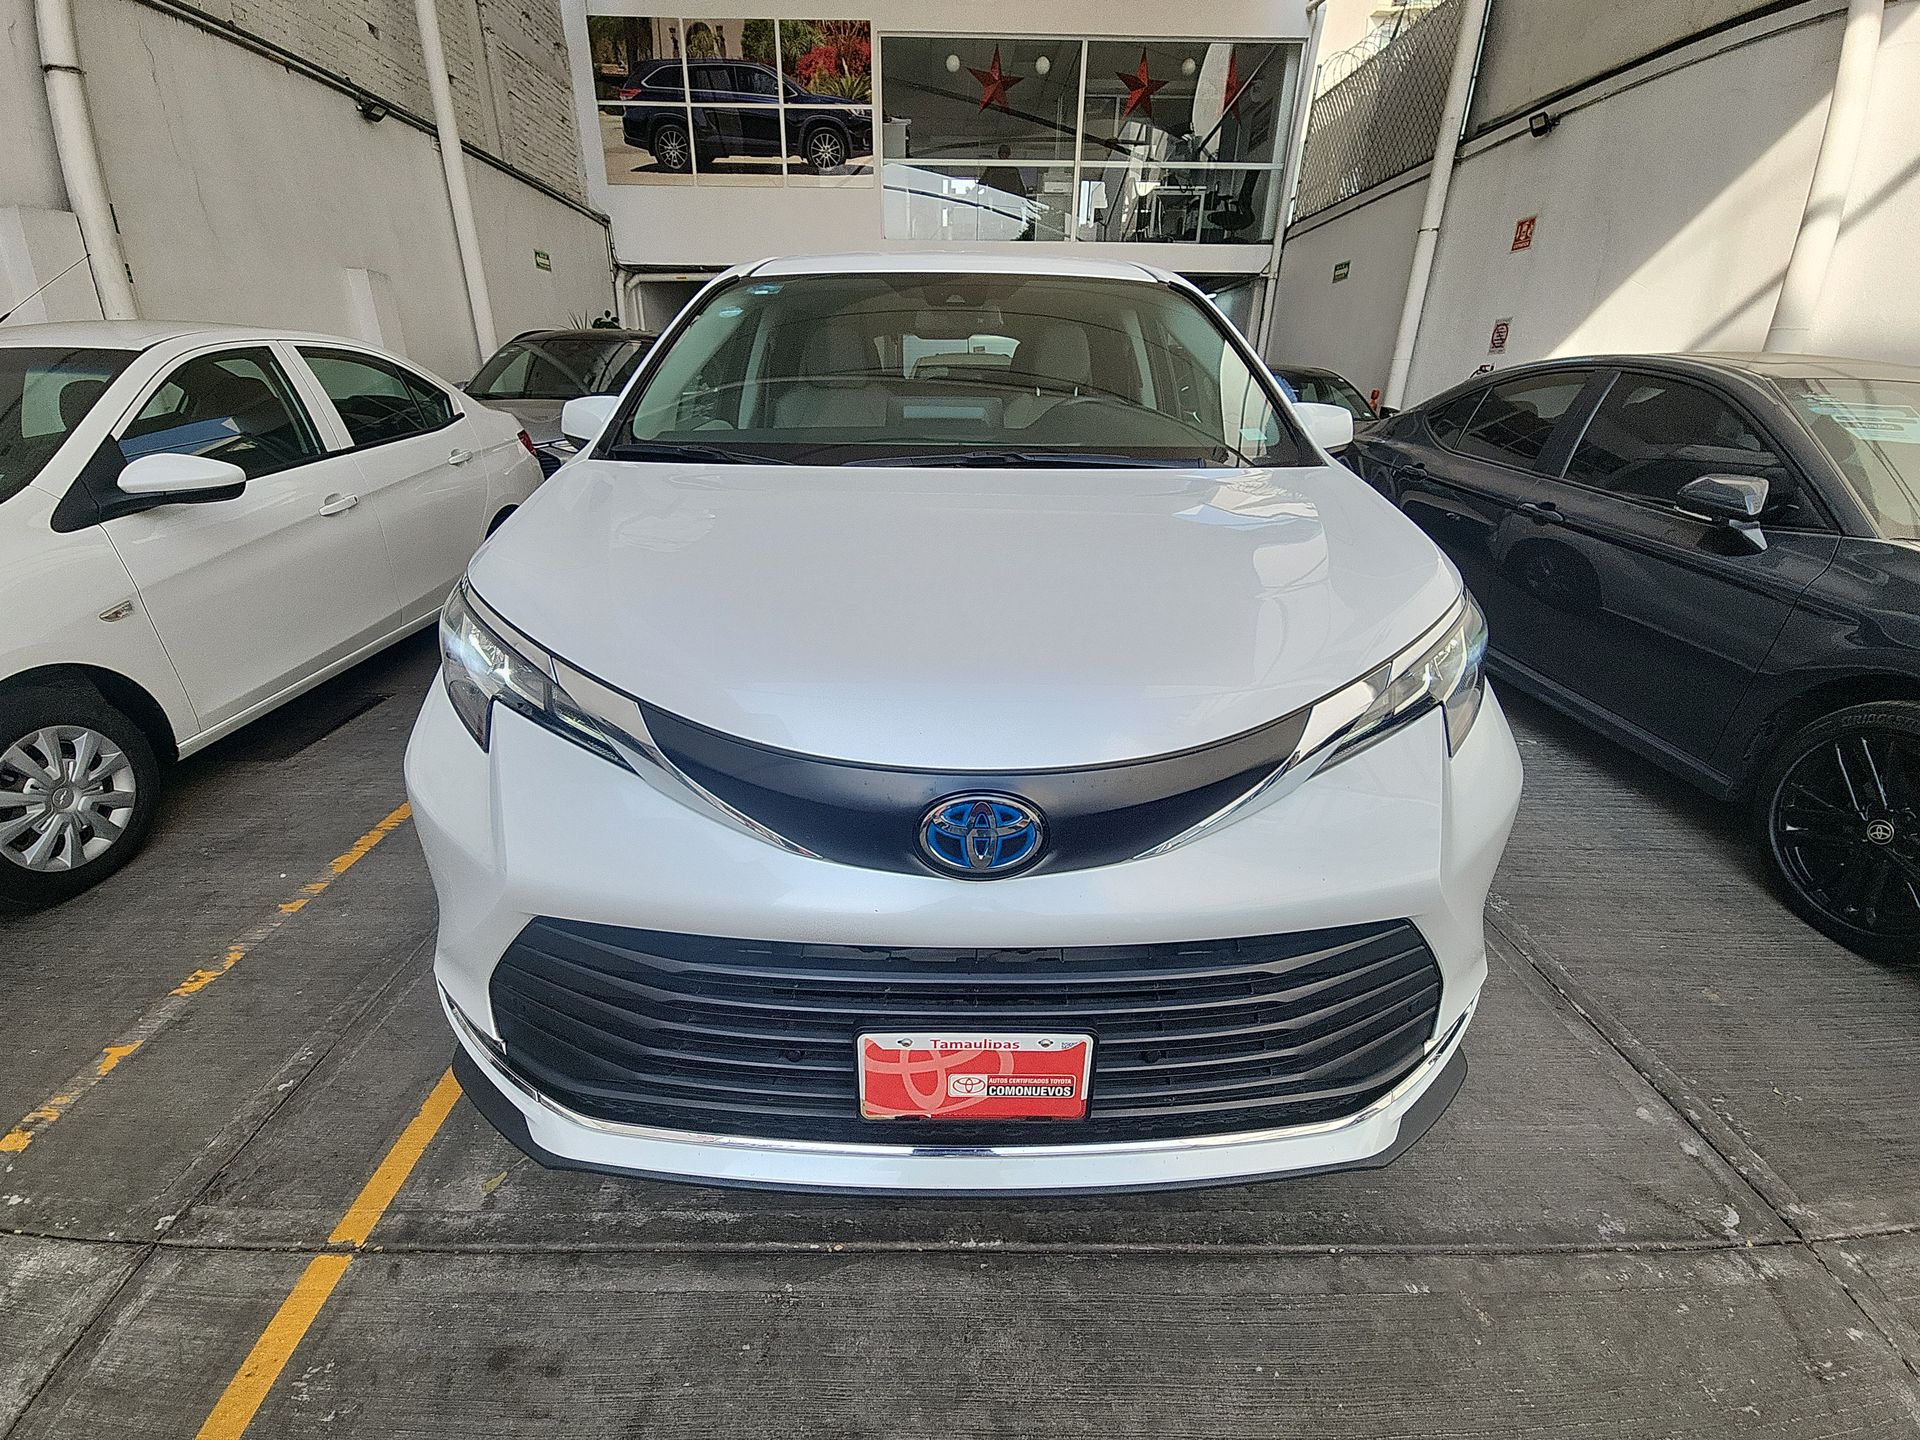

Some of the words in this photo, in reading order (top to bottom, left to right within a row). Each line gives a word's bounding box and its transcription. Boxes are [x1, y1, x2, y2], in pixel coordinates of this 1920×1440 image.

[930, 1038, 1020, 1049] Tamaulipas
[1008, 1077, 1049, 1085] CERTIFICADOS
[988, 1085, 1071, 1096] COMONUEVOS
